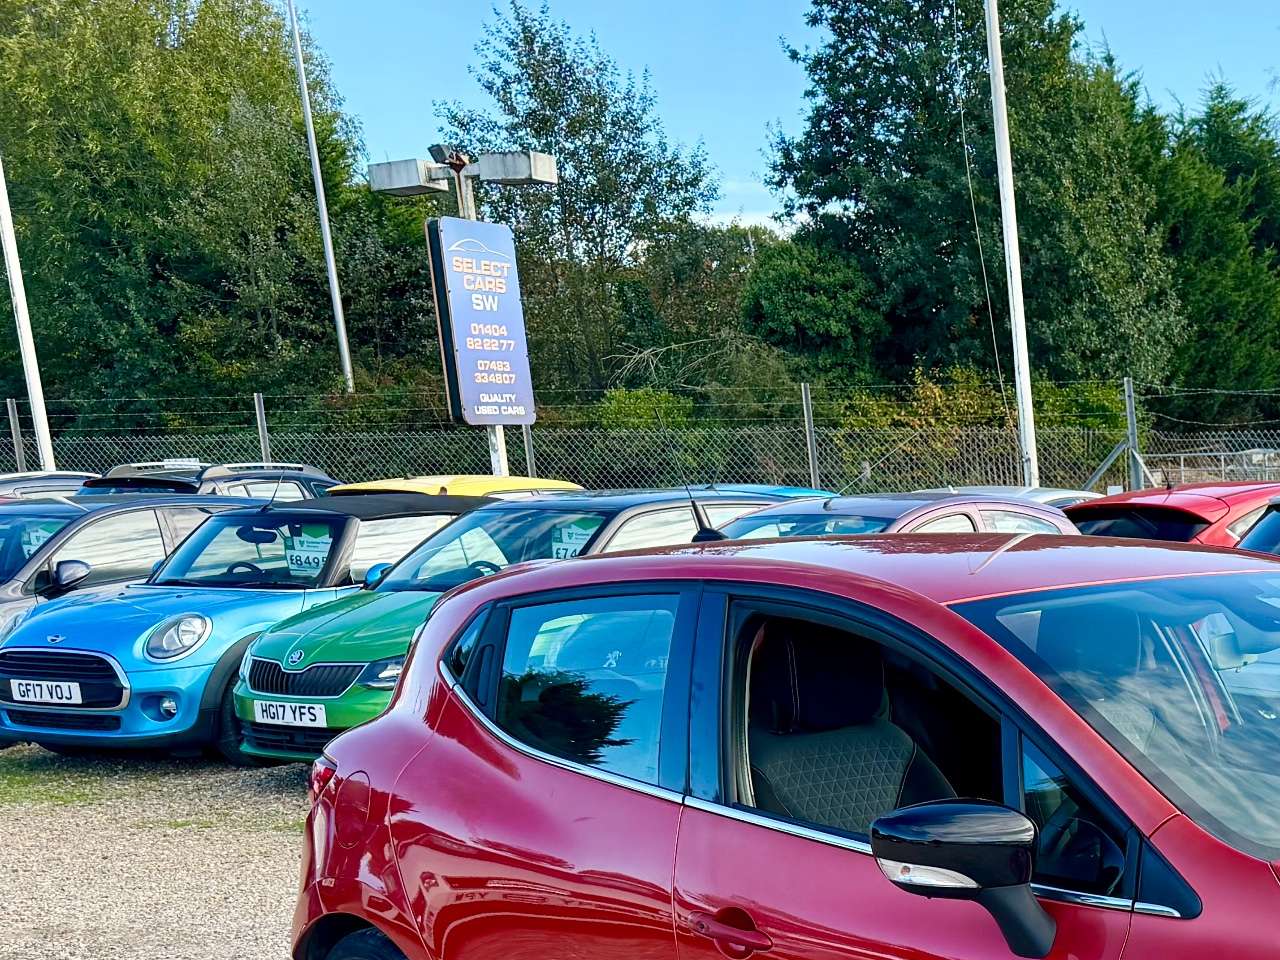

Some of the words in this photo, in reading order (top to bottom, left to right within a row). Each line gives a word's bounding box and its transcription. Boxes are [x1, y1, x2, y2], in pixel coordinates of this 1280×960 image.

[452, 256, 512, 278] SELECT
[463, 275, 506, 294] CARS
[471, 293, 498, 311] SW
[470, 323, 508, 336] 01404
[479, 393, 516, 402] QUALITY
[474, 405, 500, 415] USED
[500, 406, 526, 416] CARS
[17, 682, 43, 699] GF17
[46, 684, 73, 700] VOJ
[260, 702, 286, 721] HG17
[289, 705, 317, 722] YFS
